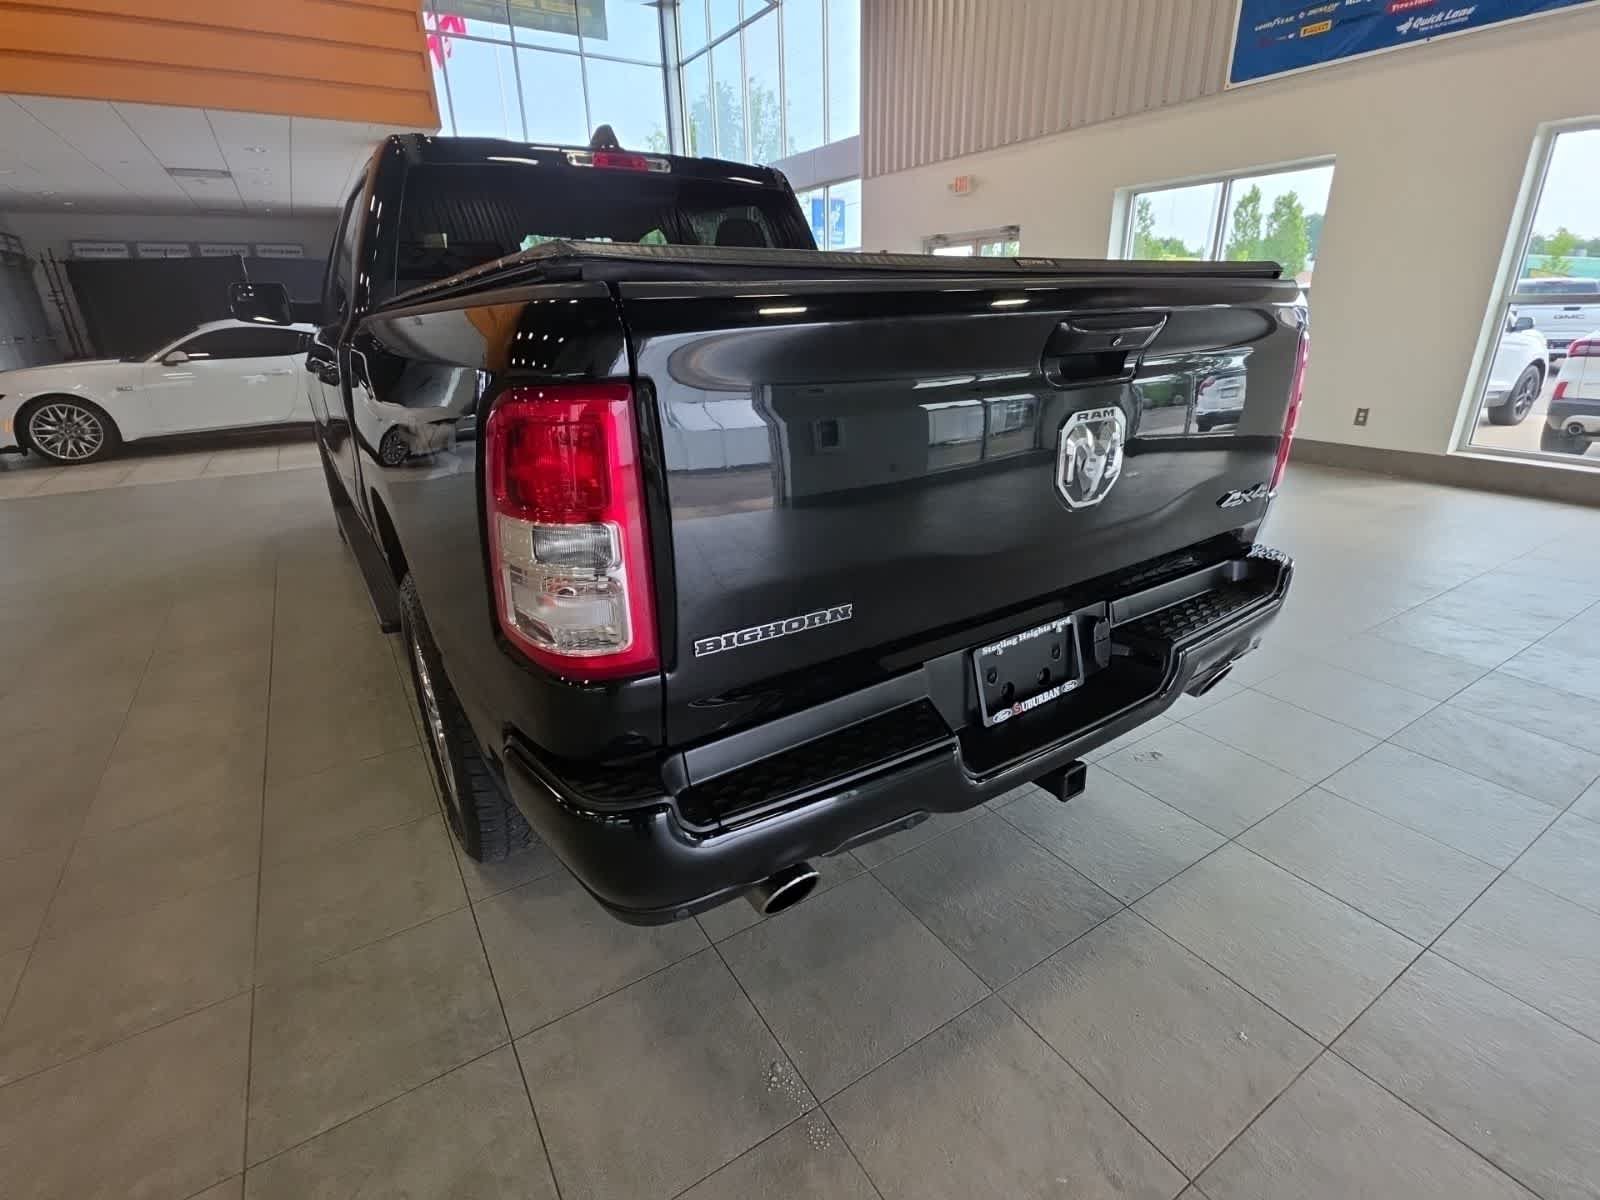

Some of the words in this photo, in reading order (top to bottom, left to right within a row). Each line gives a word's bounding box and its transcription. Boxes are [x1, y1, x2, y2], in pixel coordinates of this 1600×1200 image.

[1413, 11, 1445, 28] Quick
[1444, 6, 1477, 21] Lane
[1077, 409, 1115, 421] RAM
[694, 603, 853, 657] BIGHORN
[982, 636, 1018, 655] Sterling
[1018, 624, 1051, 641] Heights
[1050, 616, 1073, 630] Ford
[1013, 686, 1060, 715] SUBURBAN
